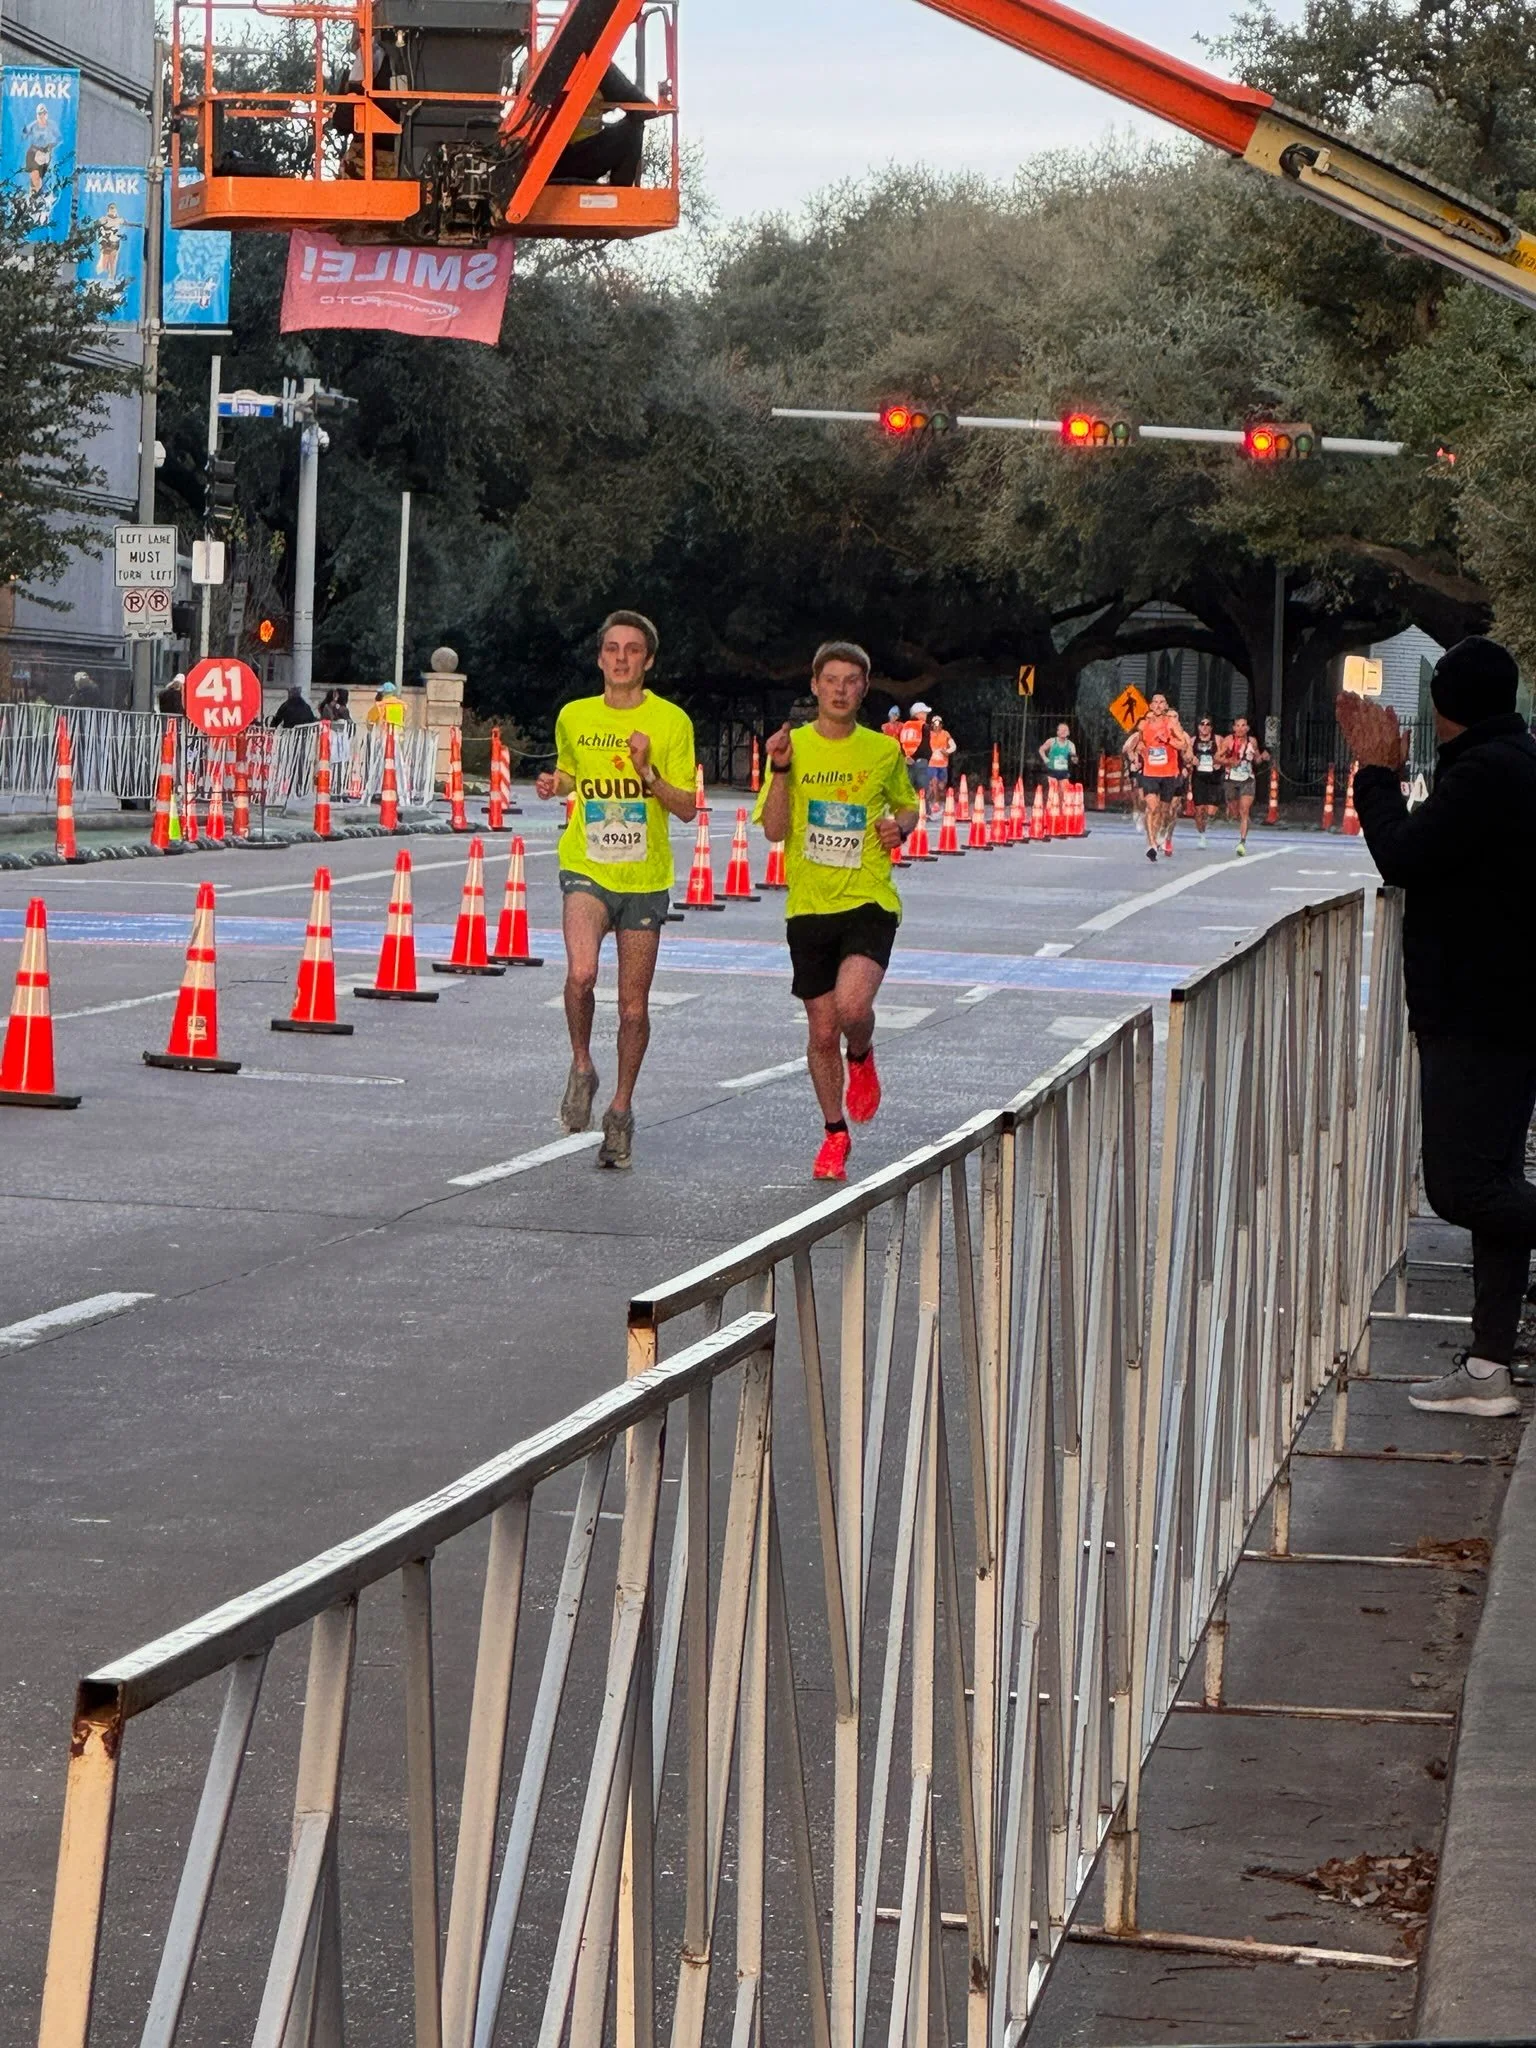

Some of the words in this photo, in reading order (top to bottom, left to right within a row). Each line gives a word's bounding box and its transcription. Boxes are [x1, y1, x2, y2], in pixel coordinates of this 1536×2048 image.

[10, 79, 71, 99] MARK
[85, 177, 139, 194] MARK
[129, 551, 161, 563] MUST
[195, 665, 242, 703] 41
[203, 706, 242, 728] KM
[577, 733, 629, 748] Achilles
[801, 771, 853, 784] Achilles
